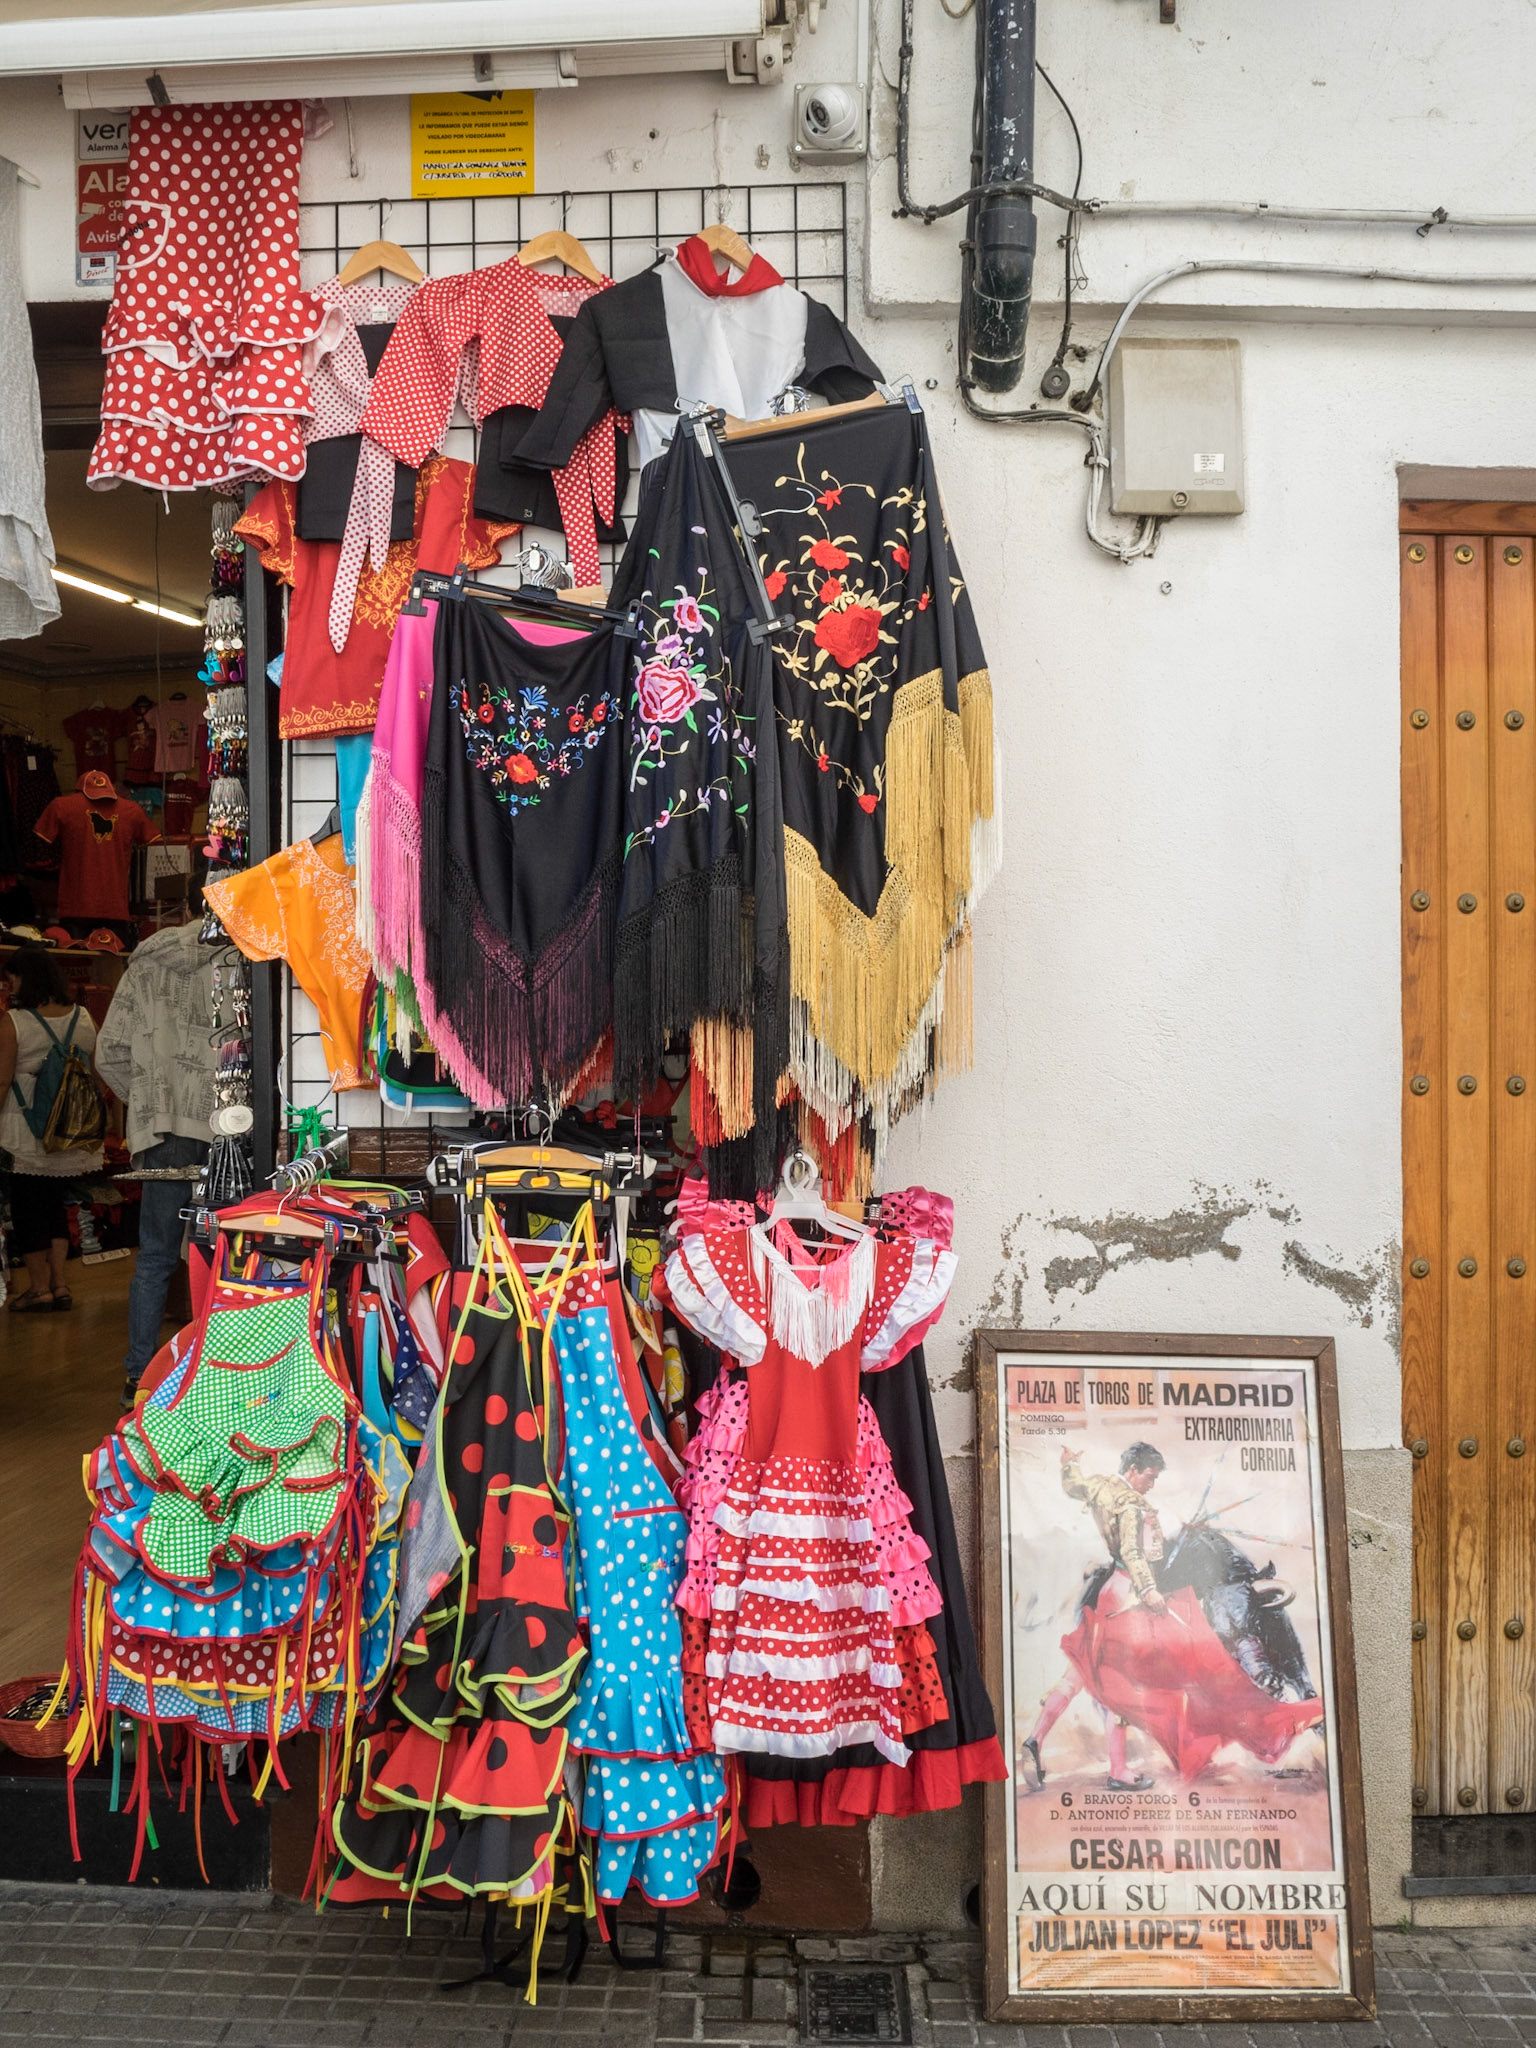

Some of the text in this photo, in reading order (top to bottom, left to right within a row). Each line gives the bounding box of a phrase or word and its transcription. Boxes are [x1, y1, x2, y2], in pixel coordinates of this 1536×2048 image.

[87, 144, 118, 152] Alarma
[1018, 1380, 1294, 1407] PLAZA DE TOROS DE MADRID
[1020, 1414, 1065, 1423] DOMINGO
[1022, 1427, 1066, 1436] Tarde 5.30
[1185, 1417, 1295, 1442] EXTRAORDINARIA
[1241, 1447, 1296, 1472] CORRIDA
[504, 1542, 559, 1559] Córdoba
[1060, 1792, 1073, 1807] 6
[1084, 1794, 1133, 1805] BRAVOS
[1136, 1794, 1178, 1805] TOROS
[1188, 1792, 1200, 1807] 6
[1050, 1809, 1297, 1821] D. ANTONIO PEREZ DE SAN FERNANDO
[1070, 1838, 1282, 1870] CESAR RINCON
[1017, 1876, 1346, 1916] AQUÍ SU NOMBRE
[1028, 1919, 1327, 1952] JULIAN LOPEZ “EL JULI”
